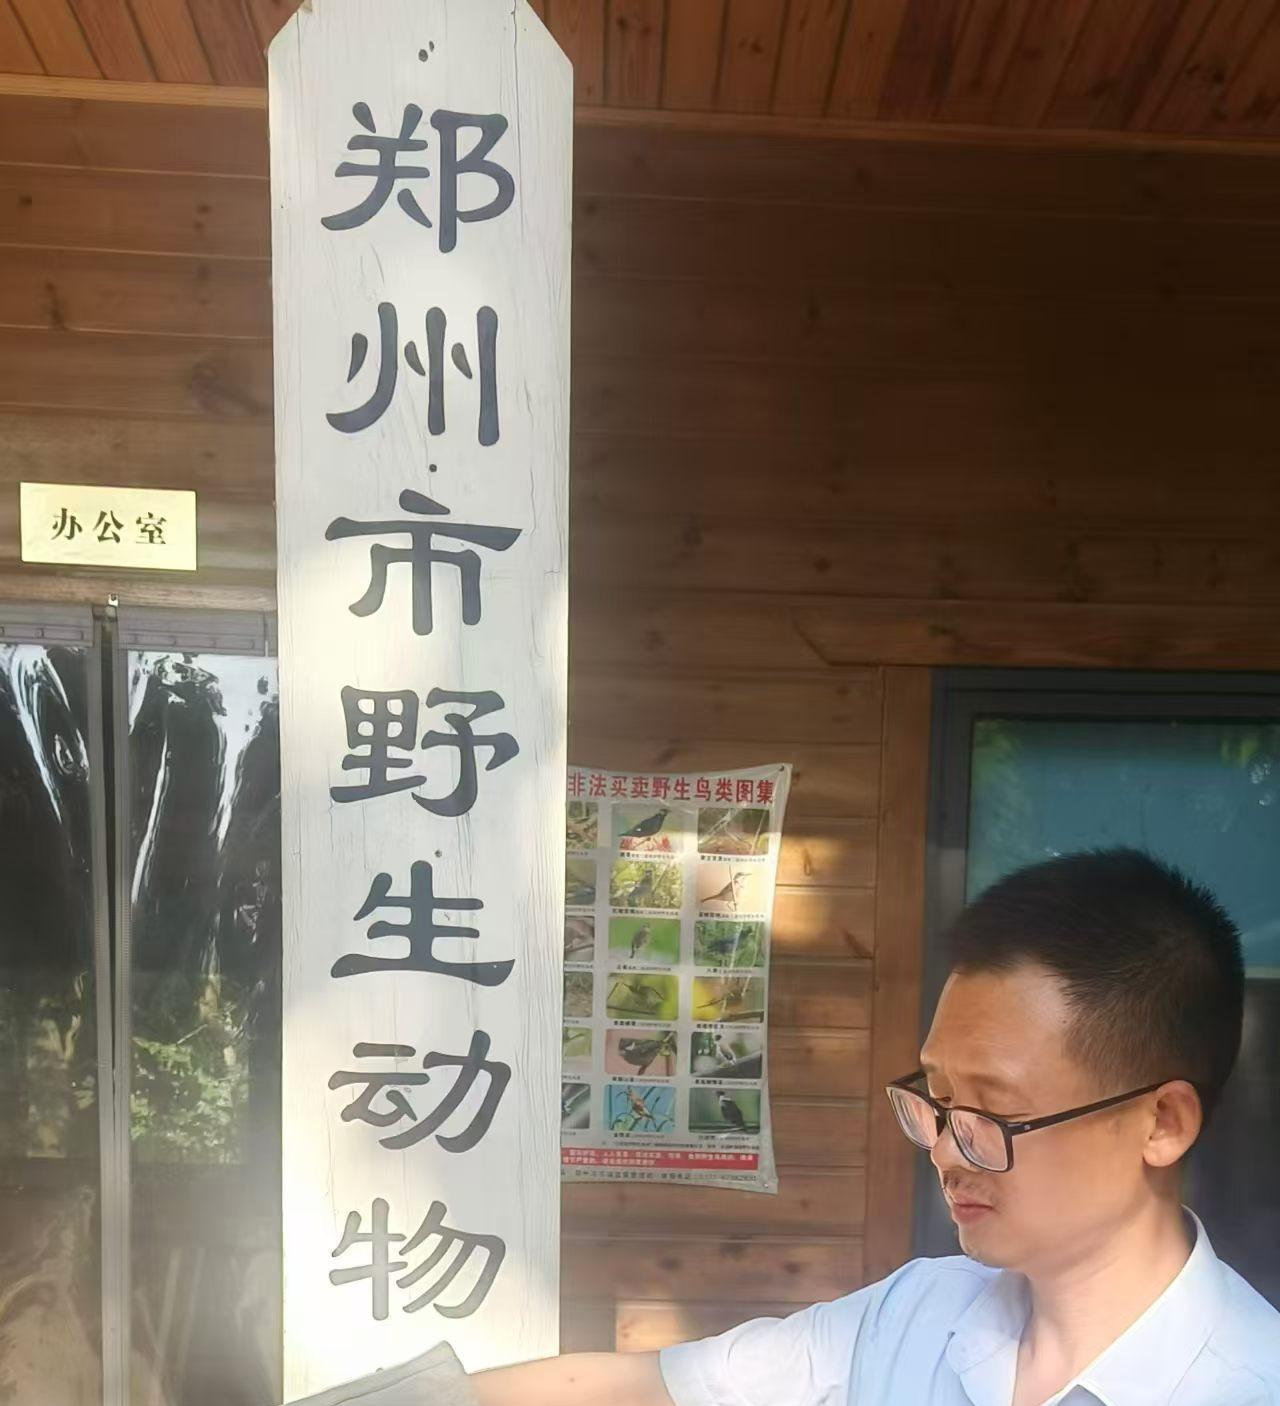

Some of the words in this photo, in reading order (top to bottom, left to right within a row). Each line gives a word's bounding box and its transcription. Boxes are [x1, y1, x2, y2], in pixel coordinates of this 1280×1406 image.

[51, 508, 168, 545] 办公室
[320, 101, 521, 1321] 郑州市野生动物
[568, 772, 775, 804] 非法买卖野生鸟类图集
